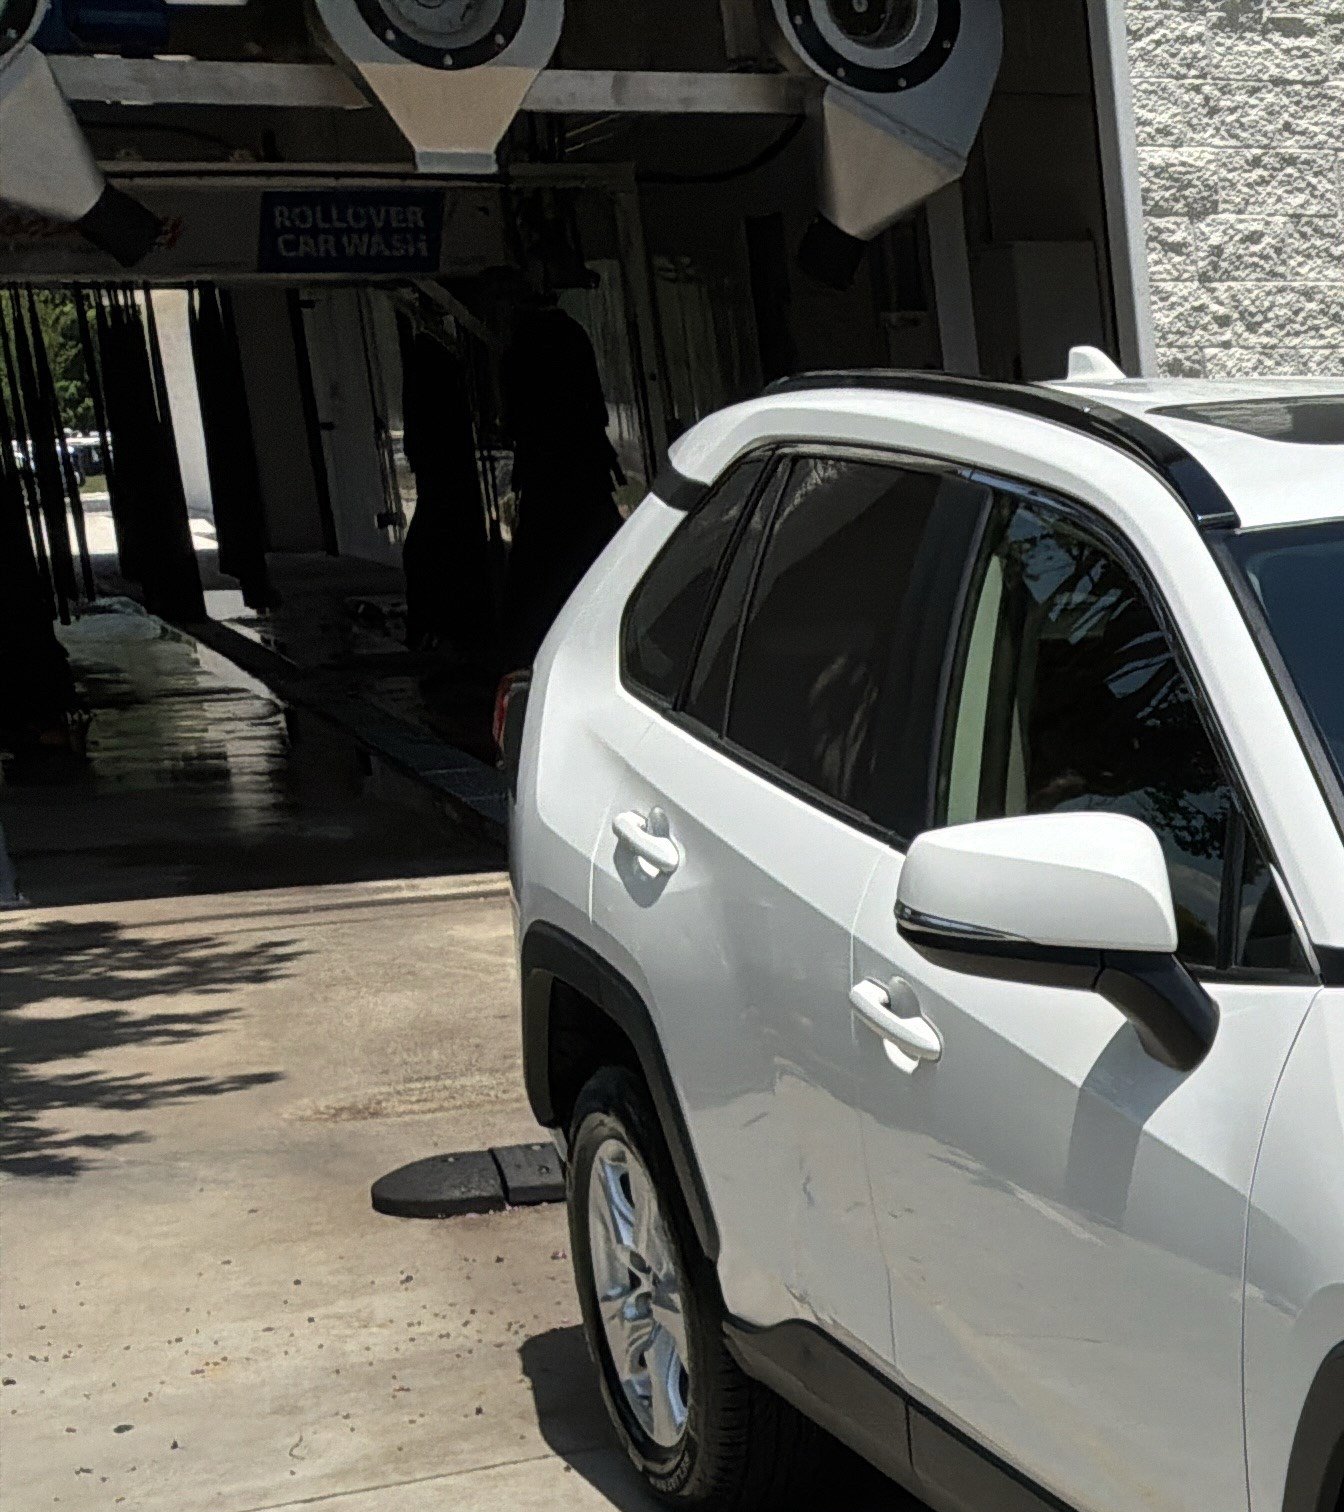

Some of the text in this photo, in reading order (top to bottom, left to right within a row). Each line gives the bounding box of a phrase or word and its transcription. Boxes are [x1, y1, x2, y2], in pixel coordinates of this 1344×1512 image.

[273, 205, 425, 229] ROLLOVER
[277, 232, 429, 257] CAR WASH
